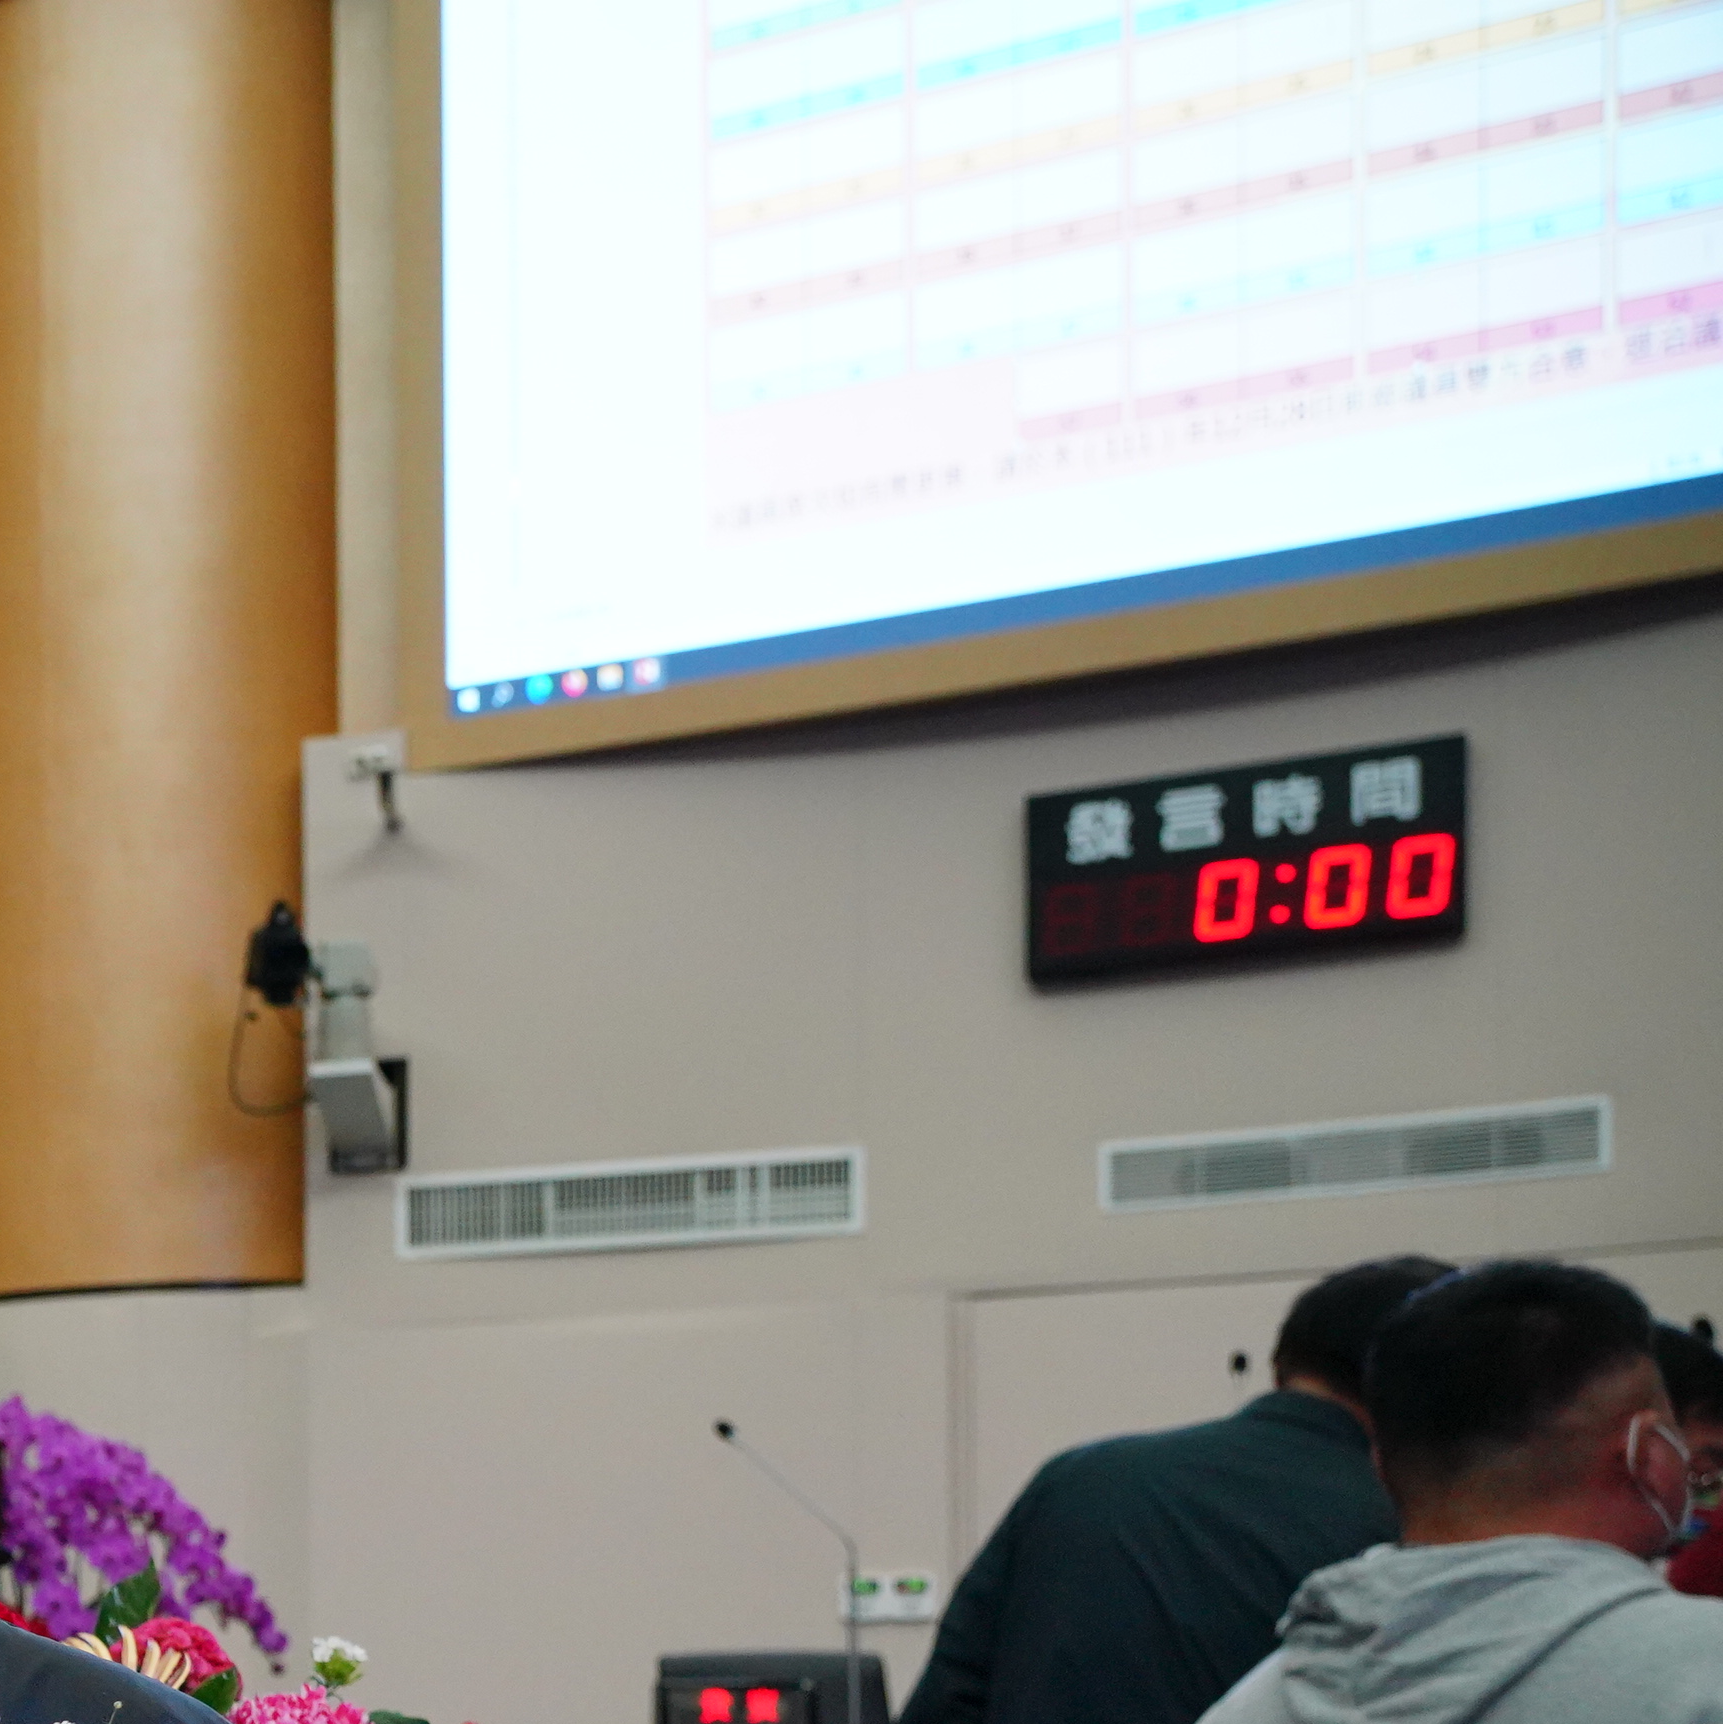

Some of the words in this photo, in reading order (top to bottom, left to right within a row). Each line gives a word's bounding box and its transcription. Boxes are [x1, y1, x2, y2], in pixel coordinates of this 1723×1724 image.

[1064, 755, 1424, 866] 發言時間
[1192, 833, 1456, 943] 0:00
